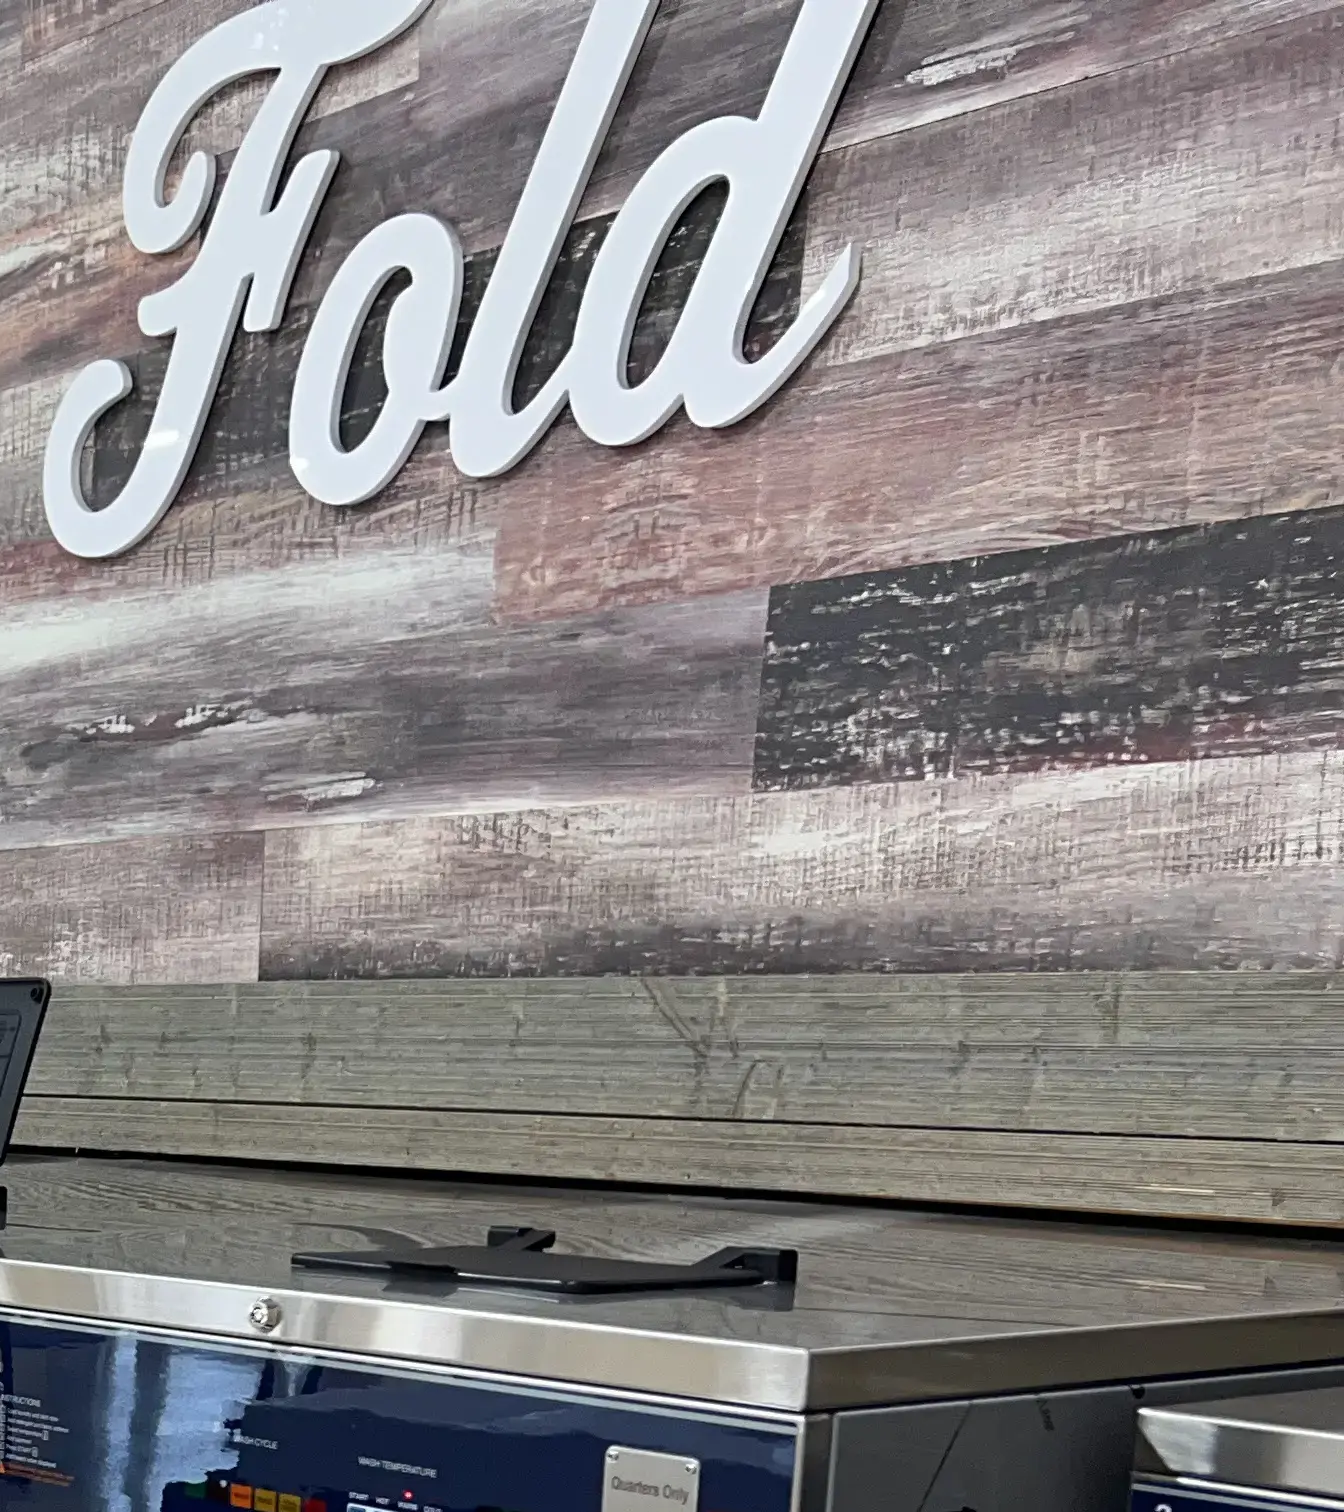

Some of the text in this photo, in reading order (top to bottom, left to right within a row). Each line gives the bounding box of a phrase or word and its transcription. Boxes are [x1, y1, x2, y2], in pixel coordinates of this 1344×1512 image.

[42, 0, 874, 560] Fold
[612, 1475, 689, 1505] Quarters Only
